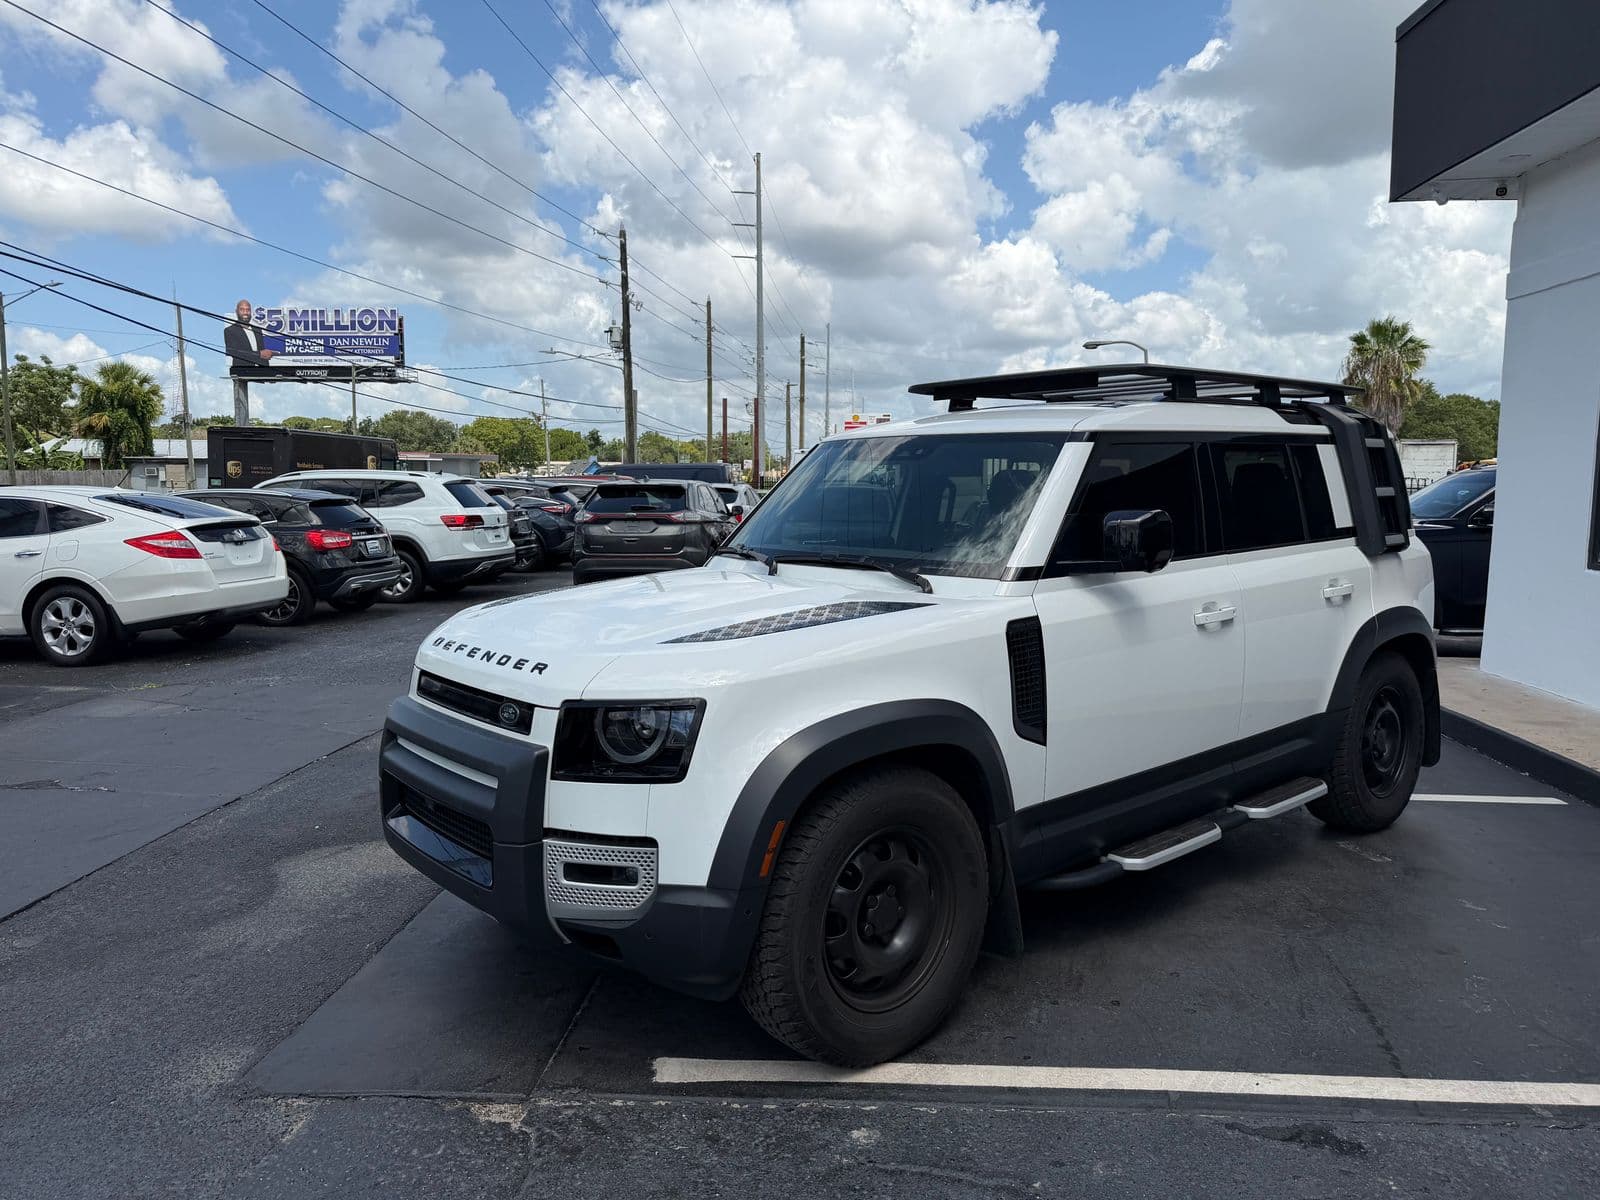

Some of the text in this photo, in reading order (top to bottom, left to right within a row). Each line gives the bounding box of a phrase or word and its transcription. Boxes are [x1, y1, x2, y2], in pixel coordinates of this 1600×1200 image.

[254, 306, 397, 332] $5 MILLION
[285, 338, 303, 346] DAN
[329, 337, 390, 346] DAN NEWLIN
[432, 636, 549, 675] DEFENDER
